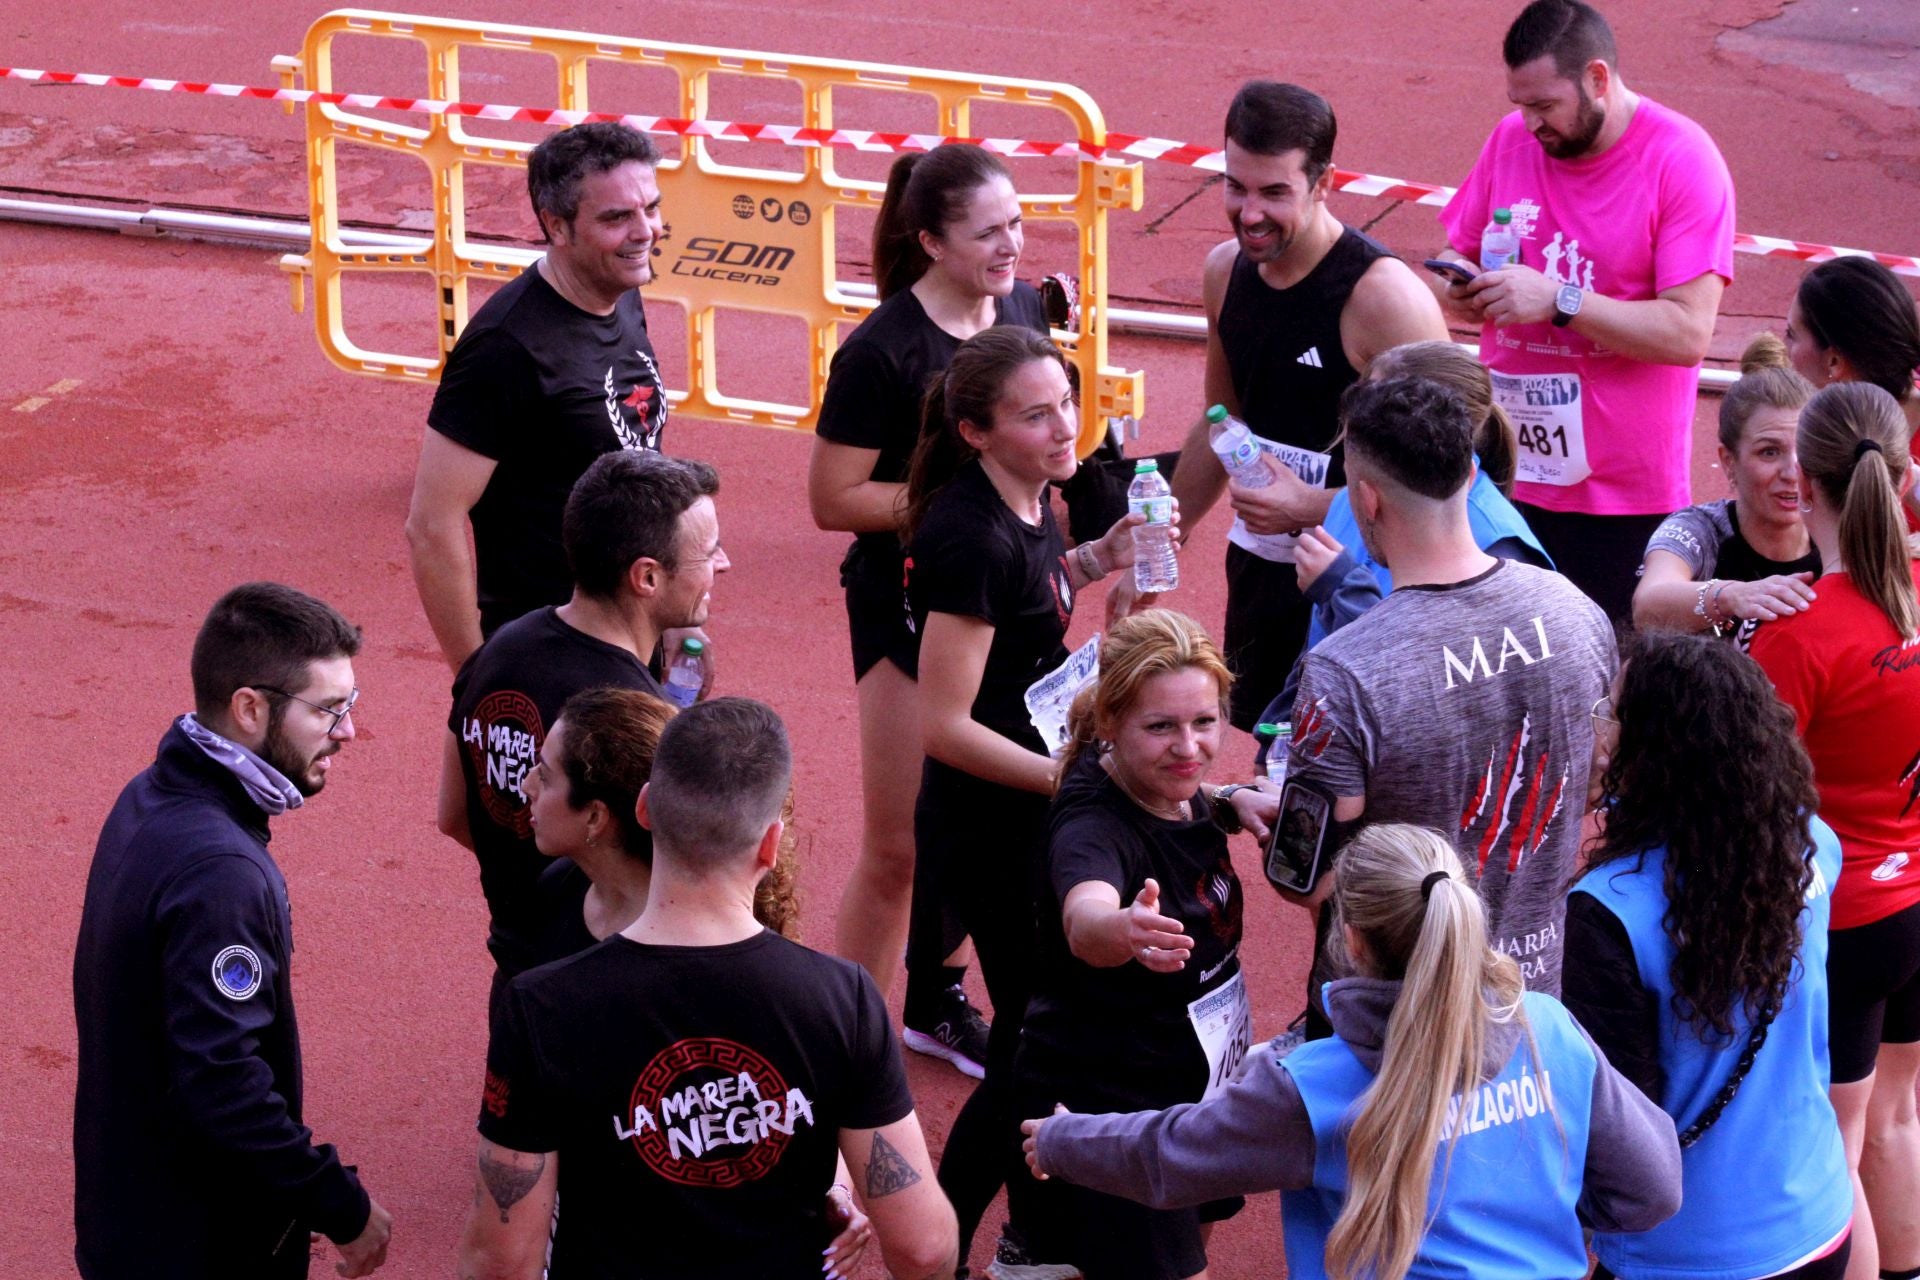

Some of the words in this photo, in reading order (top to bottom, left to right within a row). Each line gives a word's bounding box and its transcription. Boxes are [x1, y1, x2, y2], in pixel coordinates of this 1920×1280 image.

[671, 260, 782, 286] Lucena
[1522, 377, 1553, 392] 2024
[1519, 423, 1569, 458] 481
[1444, 616, 1555, 690] MAI
[462, 716, 483, 750] LA
[487, 723, 537, 767] MAREA
[613, 1104, 658, 1140] LA
[660, 1071, 762, 1126] MAREA
[667, 1088, 815, 1160] NEGRA
